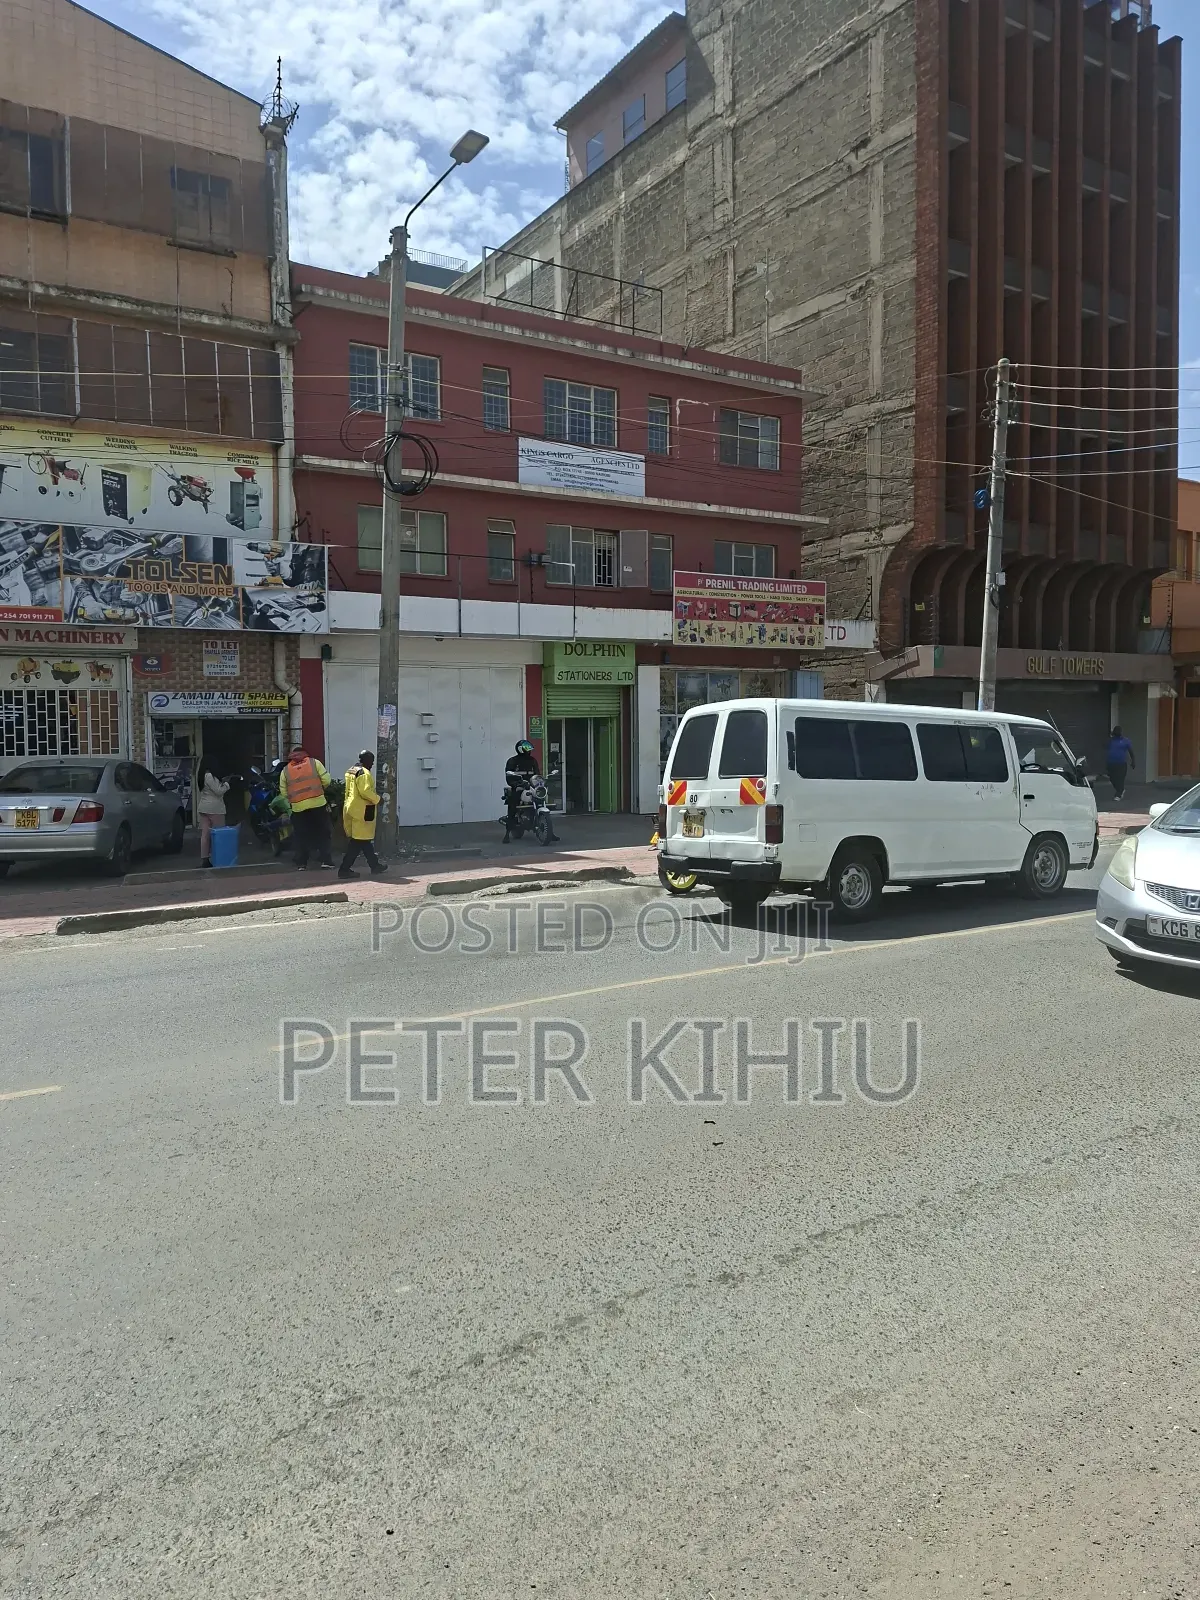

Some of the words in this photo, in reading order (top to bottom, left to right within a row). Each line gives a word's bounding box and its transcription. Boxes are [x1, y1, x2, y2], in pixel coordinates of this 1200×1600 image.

[37, 429, 73, 437] CONCRETE
[40, 435, 71, 443] CUTTERS
[106, 436, 135, 444] WELDING
[104, 442, 138, 450] MACHINES
[170, 444, 198, 452] WALKING
[169, 450, 198, 458] TRACTOR
[522, 448, 545, 456] KINGS
[546, 451, 574, 460] CARGO
[591, 457, 626, 467] AGENCIES
[627, 462, 640, 470] LTD
[125, 558, 234, 586] TOLSEN
[127, 582, 168, 593] TOOLS
[171, 585, 196, 594] AND
[200, 586, 234, 596] MORE
[706, 578, 736, 590] PRENIL
[737, 580, 774, 592] TRADING
[776, 583, 808, 594] LIMITED
[15, 628, 126, 644] MACHINERY
[825, 626, 846, 640] TD
[204, 640, 218, 648] TO
[221, 642, 238, 650] LET
[564, 642, 626, 657] DOLPHIN
[1027, 656, 1057, 674] GULF
[1060, 657, 1105, 676] TOWERS
[557, 670, 612, 681] STATIONERS
[618, 672, 634, 681] LTD
[172, 692, 215, 700] ZAMADI
[217, 692, 246, 700] AUTO
[248, 692, 286, 700] SPARES
[531, 717, 540, 725] 05
[690, 794, 698, 803] 80
[21, 810, 36, 818] KBL
[16, 820, 36, 828] 517R
[1162, 920, 1188, 938] KCG
